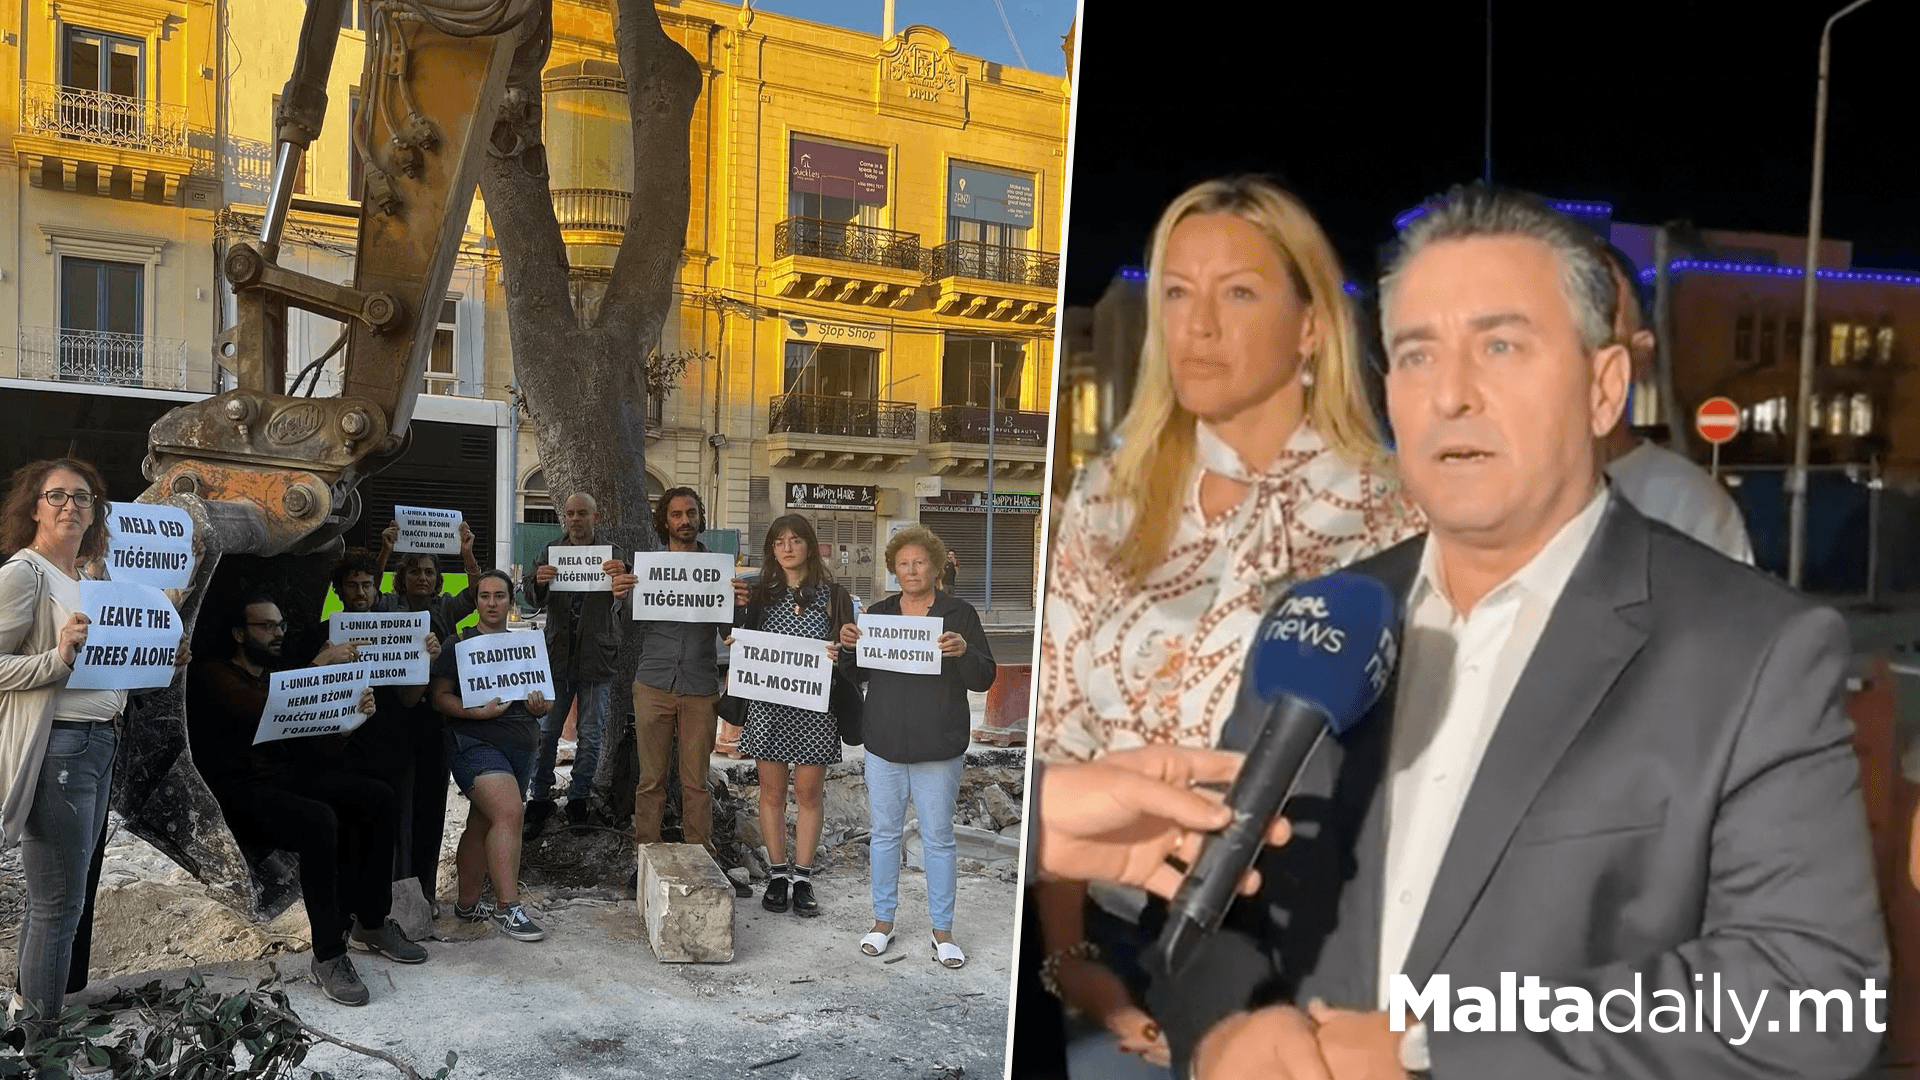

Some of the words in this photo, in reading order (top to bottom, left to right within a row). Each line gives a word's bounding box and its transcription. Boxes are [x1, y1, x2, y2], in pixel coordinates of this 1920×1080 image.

[908, 86, 938, 102] MMIX
[819, 324, 844, 338] Stop
[848, 326, 876, 341] Shop
[837, 487, 856, 500] HARE
[1014, 494, 1030, 507] HARE
[118, 516, 157, 535] MELA
[159, 520, 184, 538] QED
[429, 520, 450, 528] BŻONN
[410, 541, 445, 549] F'QALBKOM
[114, 546, 188, 570] TIĠĠENNU?
[558, 556, 582, 566] MELA
[585, 556, 602, 566] QED
[556, 571, 606, 582] TIĠĠENNU?
[649, 567, 688, 582] MELA
[692, 568, 721, 583] QED
[643, 590, 725, 607] TIĠĠENNU?
[1277, 596, 1330, 618] net
[100, 606, 142, 628] LEAVE
[147, 609, 170, 629] THE
[340, 620, 378, 630] L-UNIKA
[380, 620, 411, 629] ĦDURA
[414, 619, 422, 627] LI
[381, 634, 412, 645] BŻONN
[868, 626, 930, 641] TRADITURI
[1264, 619, 1346, 654] news
[85, 646, 128, 666] TREES
[130, 647, 175, 666] ALONE
[351, 651, 380, 663] ĊĊTU
[382, 652, 401, 662] HIJA
[404, 651, 420, 660] DIK
[468, 645, 536, 665] TRADITURI
[743, 645, 820, 669] TRADITURI
[863, 646, 934, 662] TAL-MOSTIN
[280, 676, 320, 691] L-UNIKA
[322, 671, 353, 685] ĦDURA
[356, 670, 364, 680] LI
[370, 668, 406, 679] ALBKOM
[468, 670, 546, 692] TAL-MOSTIN
[737, 670, 823, 696] TAL-MOSTIN
[287, 694, 318, 708] HEMM
[321, 689, 353, 703] BŻONN
[273, 711, 317, 722] TQAĊĊTU
[320, 708, 339, 720] HIJA
[342, 705, 356, 716] DIK
[282, 725, 340, 734] F'QALBKOM
